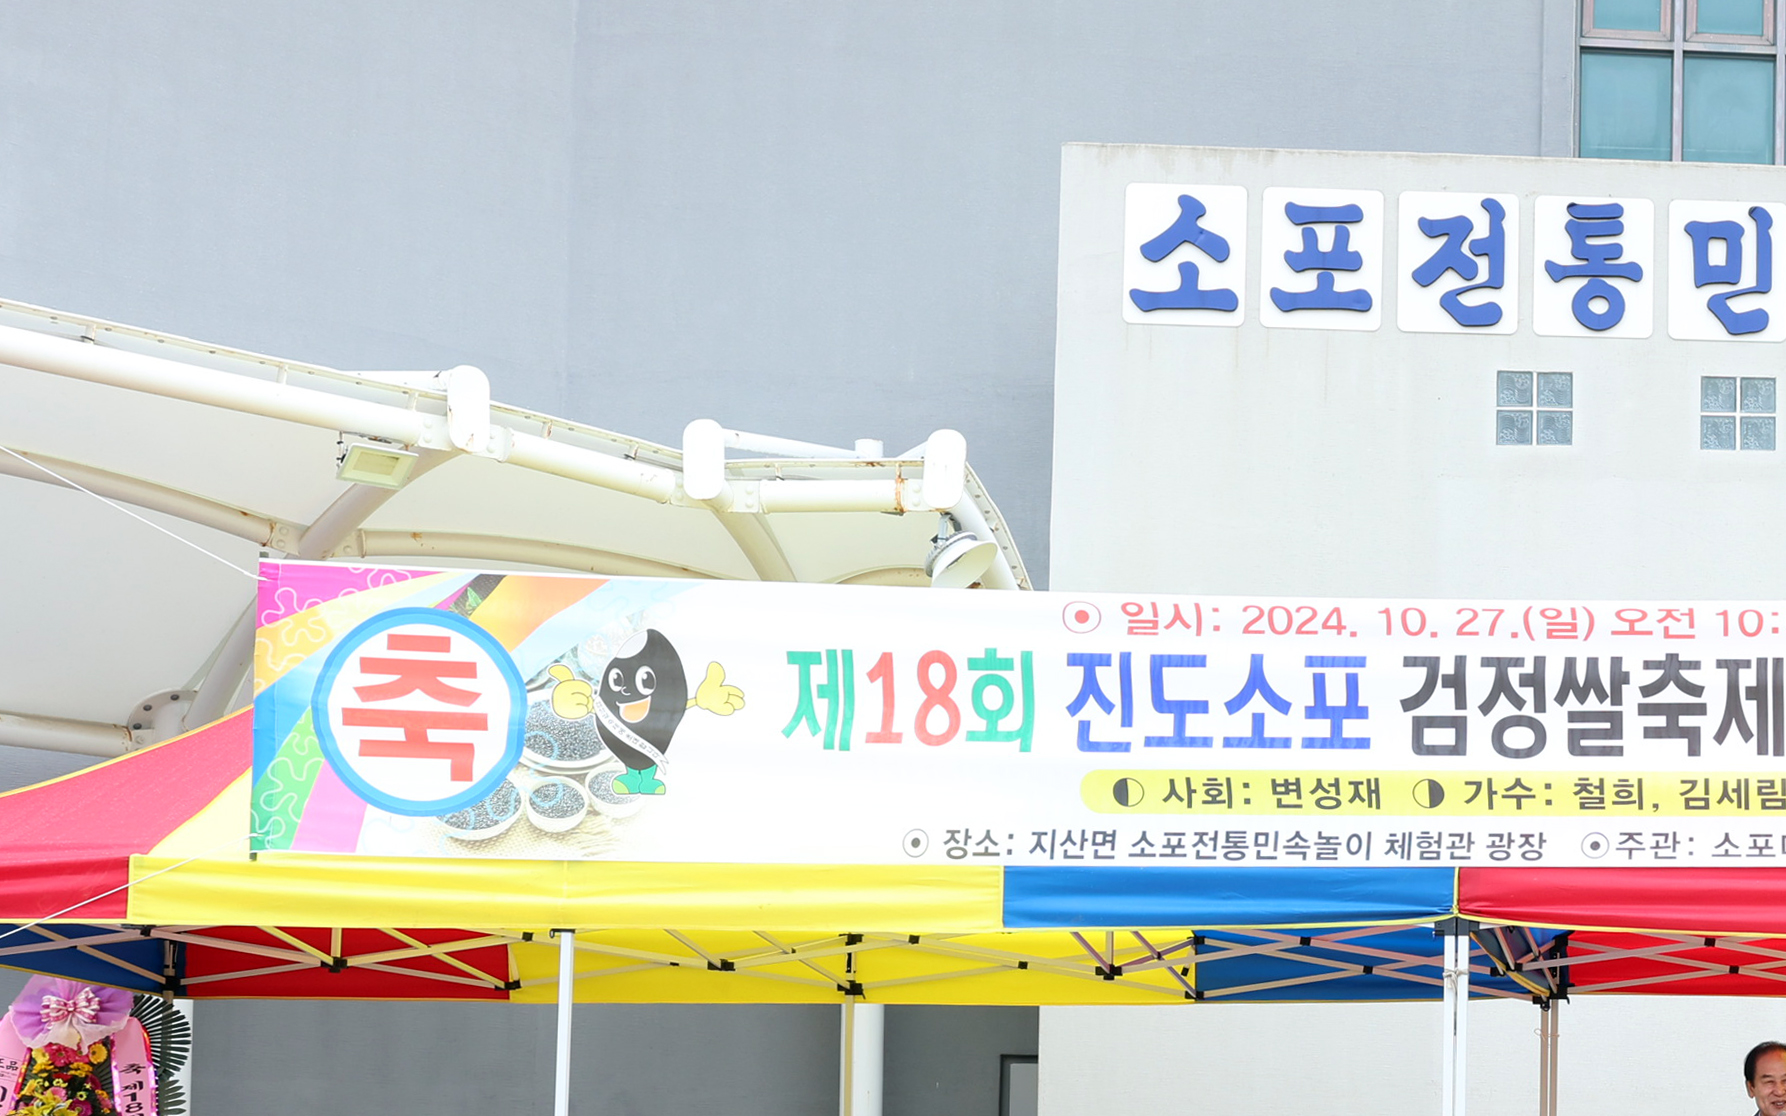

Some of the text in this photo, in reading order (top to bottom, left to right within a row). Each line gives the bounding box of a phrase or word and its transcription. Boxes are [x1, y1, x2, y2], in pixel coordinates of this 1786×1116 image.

[1120, 601, 1221, 637] 일시:
[1241, 604, 1358, 638] 2024.
[1377, 607, 1439, 639] 10.
[1455, 605, 1596, 642] 27.(일)
[1610, 607, 1696, 640] 오전
[341, 633, 489, 783] 축
[781, 647, 1036, 753] 제18회
[1065, 651, 1372, 753] 진도소포
[1399, 652, 1785, 760] 검정쌀축제
[1162, 776, 1251, 809] 사회:
[1271, 777, 1381, 810] 변성재
[1464, 777, 1553, 810] 가수:
[1573, 777, 1659, 811] 철희,
[944, 828, 1547, 861] 장소: 지산면 소포전통민속놀이 체험관 광장
[1616, 831, 1694, 860] 주관:
